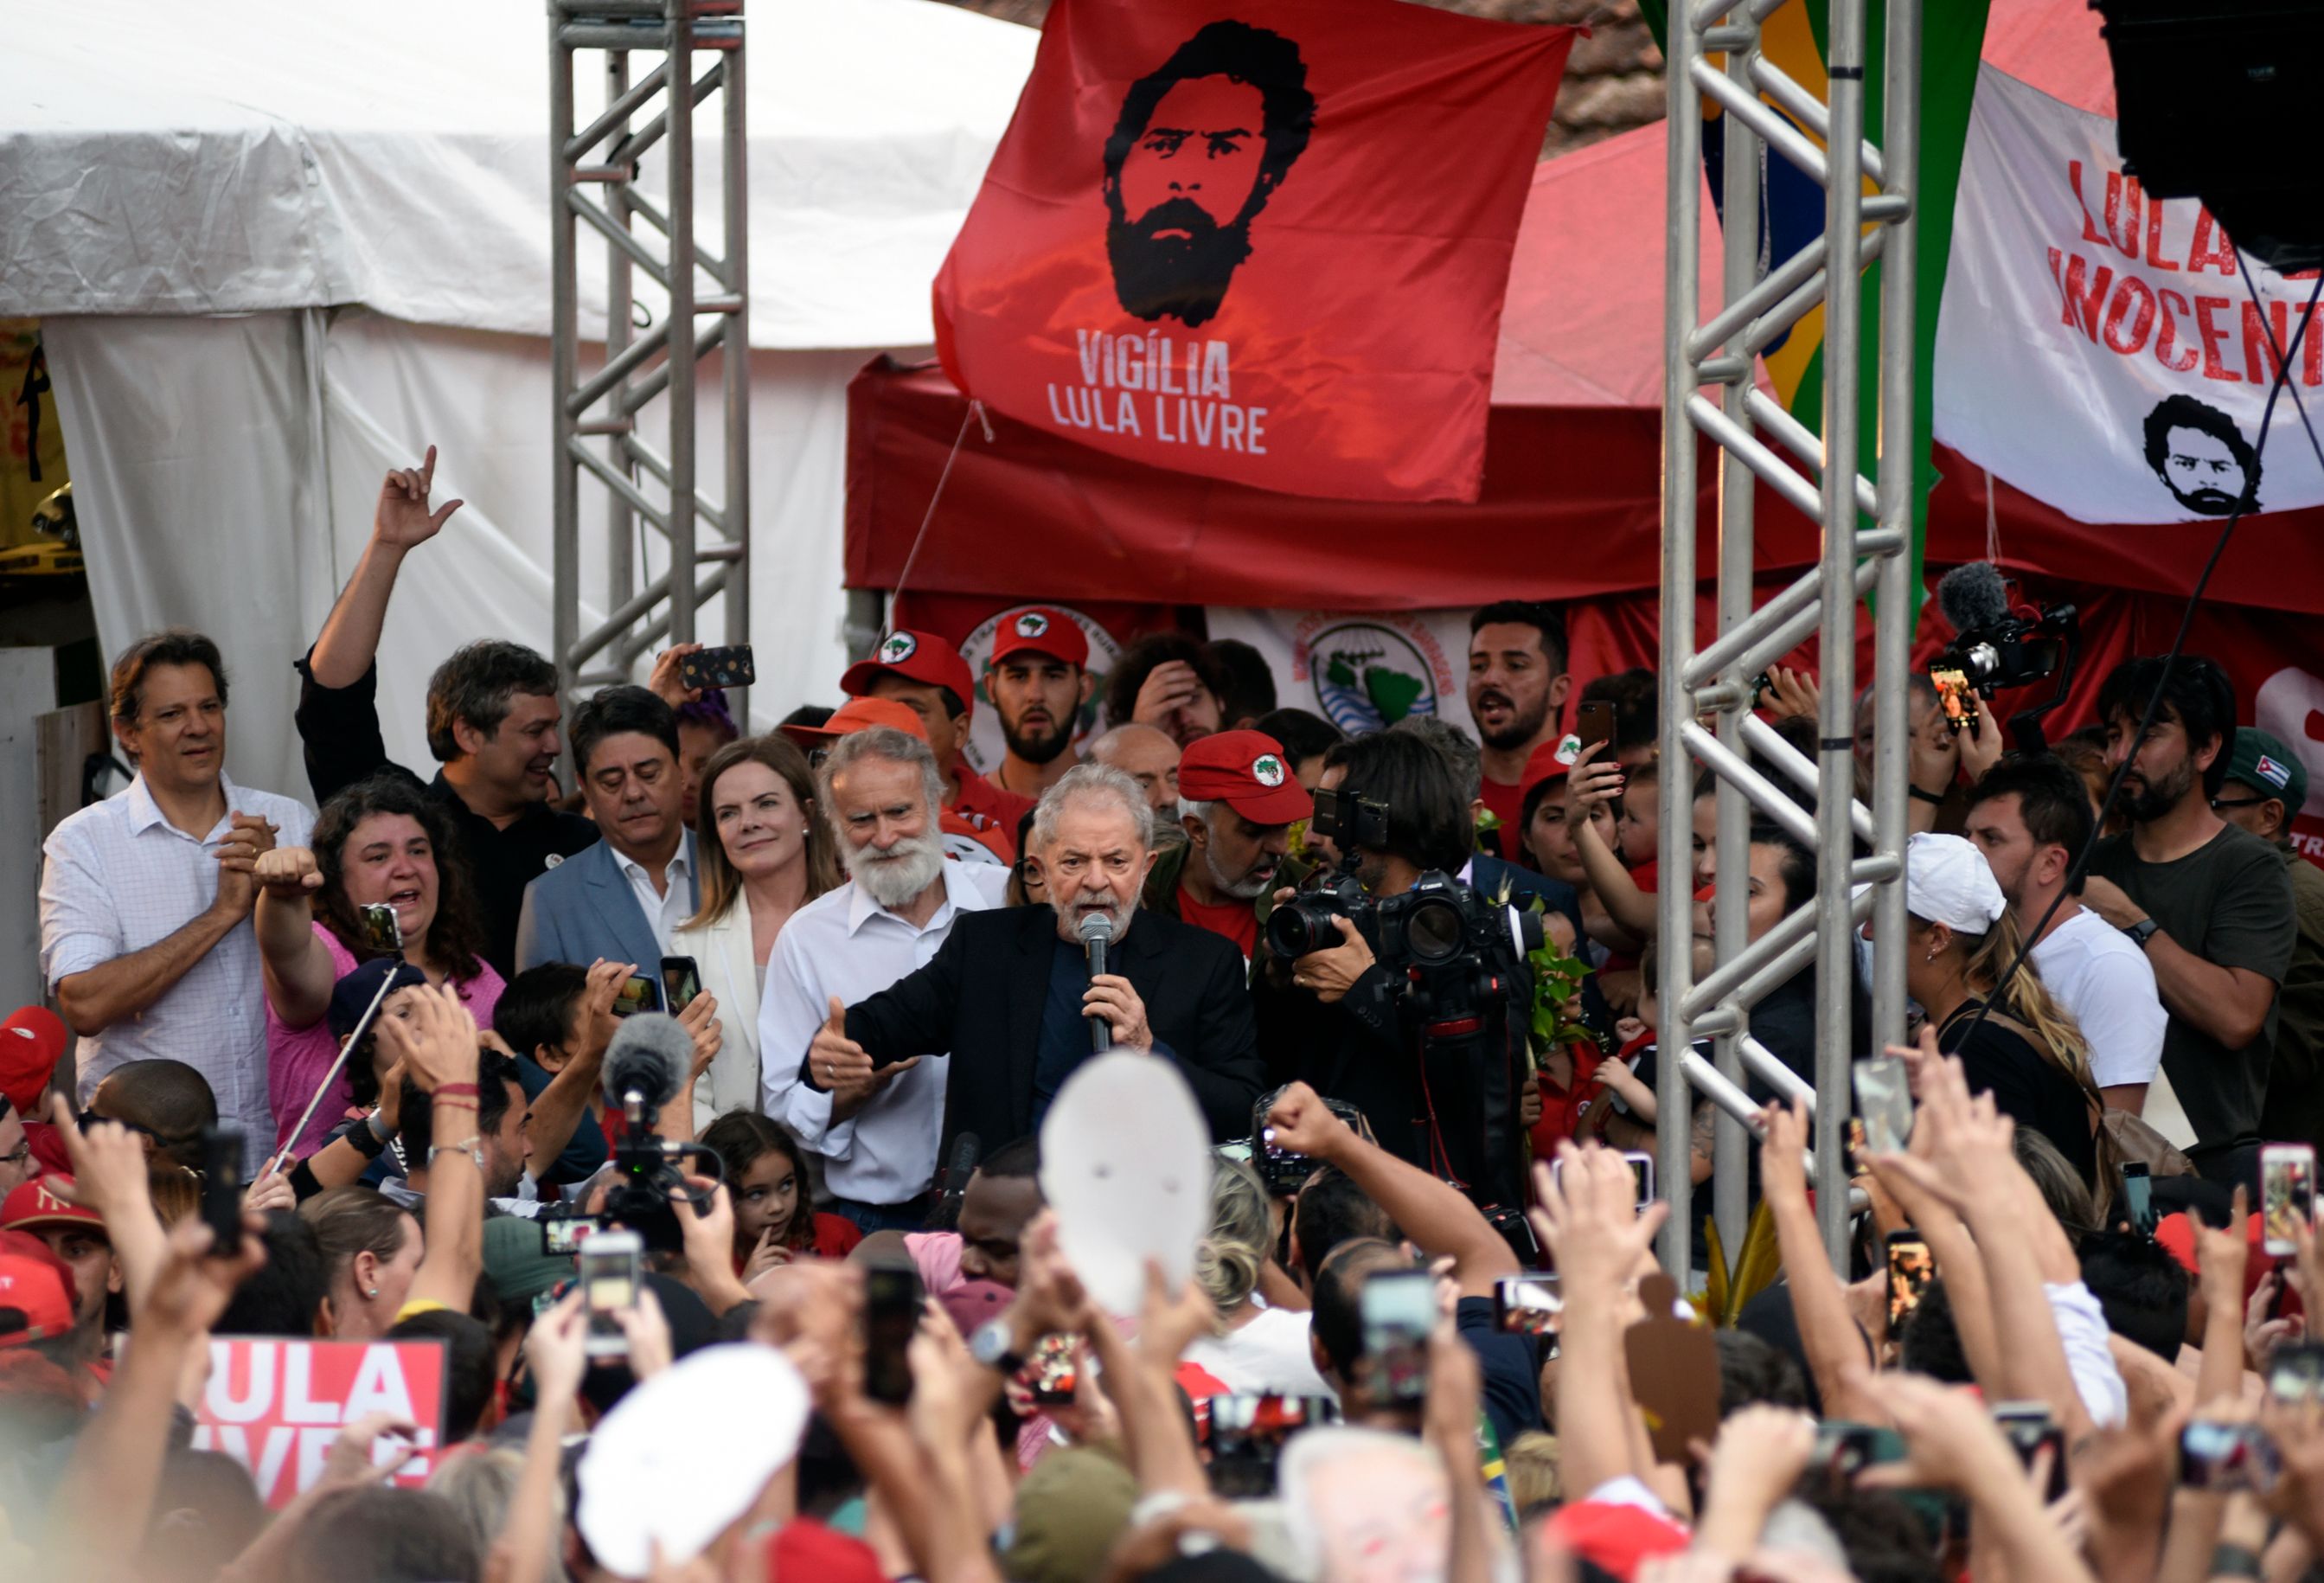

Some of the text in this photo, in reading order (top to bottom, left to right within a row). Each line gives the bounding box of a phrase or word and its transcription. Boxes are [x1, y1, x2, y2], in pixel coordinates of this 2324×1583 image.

[2069, 159, 2237, 276] LULA
[1076, 328, 1232, 399] VIGÍLIA
[1047, 382, 1268, 455] LULA LIVRE
[2289, 831, 2324, 859] TR
[204, 1342, 417, 1424] ULA
